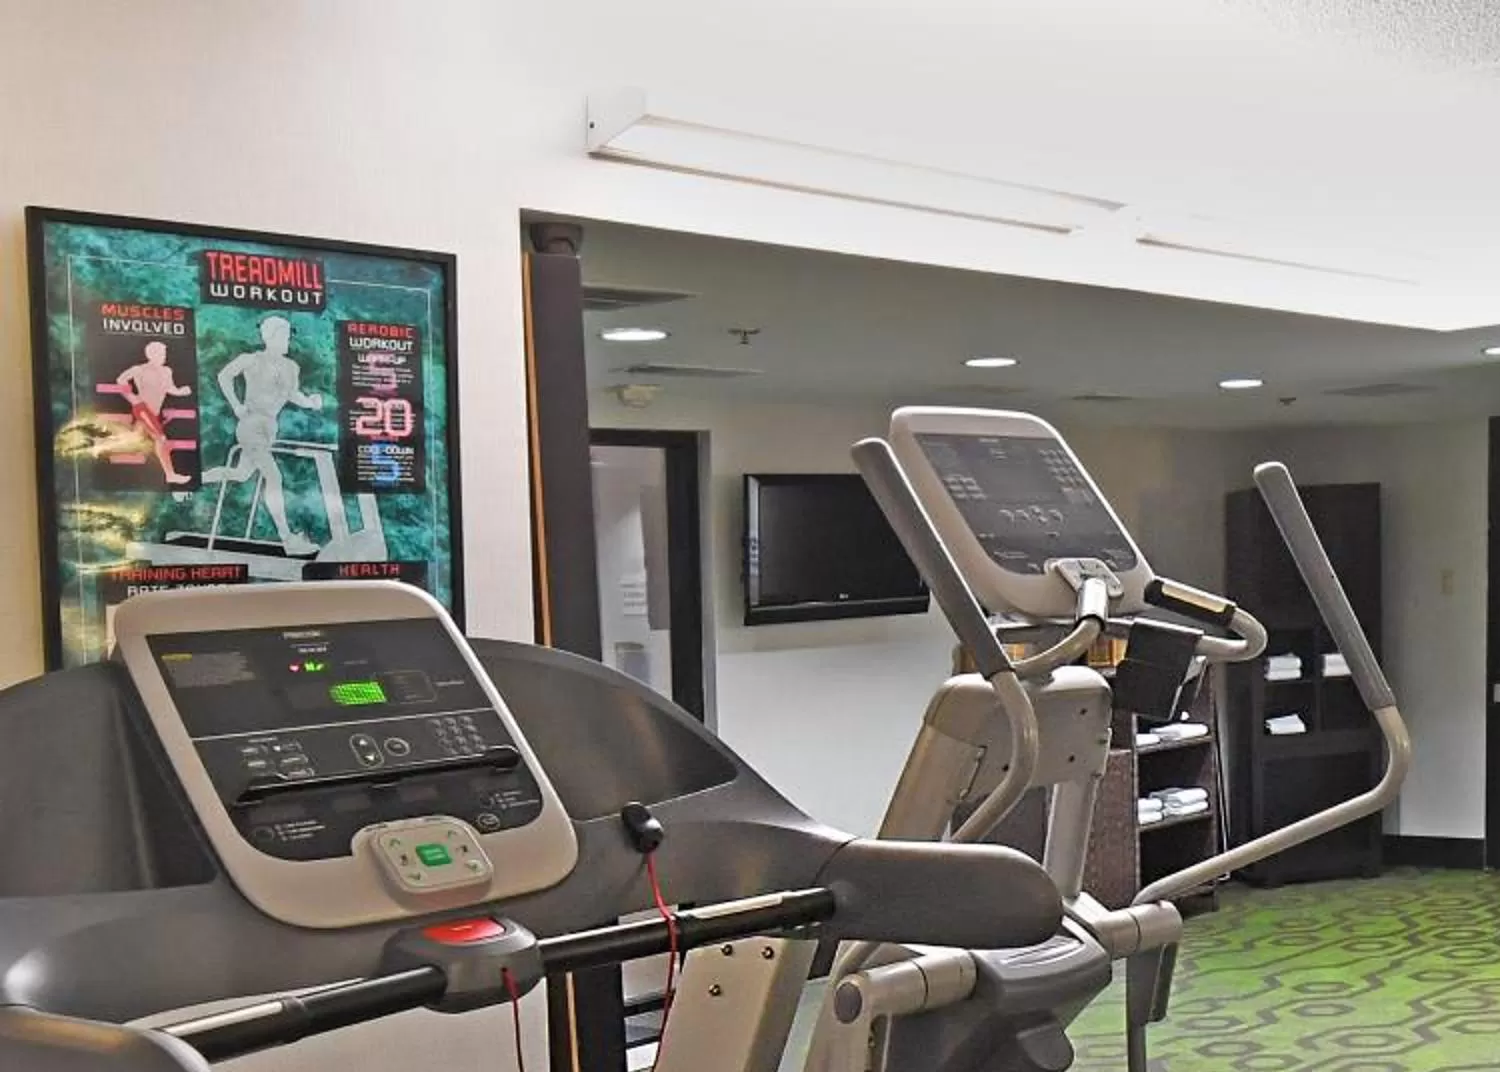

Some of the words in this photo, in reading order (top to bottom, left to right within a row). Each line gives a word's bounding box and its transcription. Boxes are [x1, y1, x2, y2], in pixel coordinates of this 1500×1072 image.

[206, 252, 323, 290] TREADMILL
[209, 283, 323, 305] WORKOUT
[101, 303, 185, 320] MUSCLES
[103, 318, 185, 335] INVOLVED
[347, 323, 414, 338] AEROBIC
[349, 337, 414, 352] WORKOUT
[355, 397, 413, 436] 20
[111, 566, 186, 582] TRAINING
[191, 564, 240, 579] HEART
[339, 563, 400, 577] HEALTH
